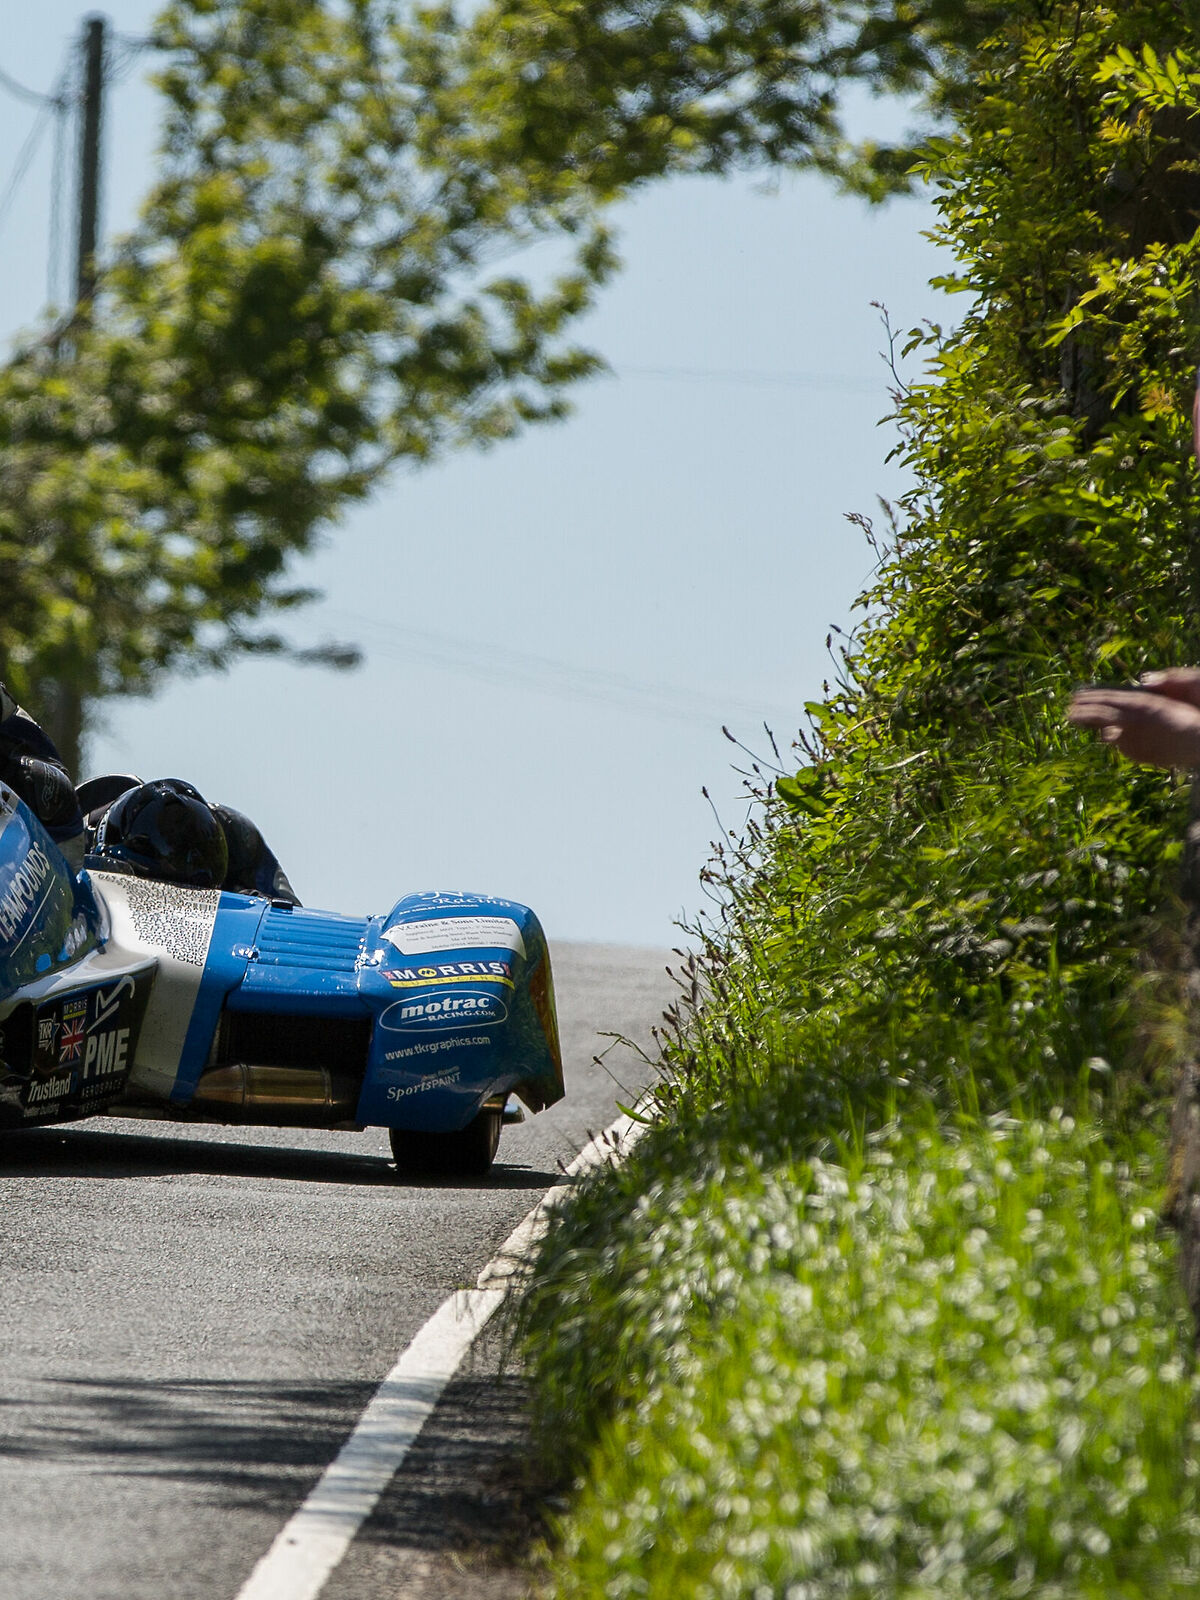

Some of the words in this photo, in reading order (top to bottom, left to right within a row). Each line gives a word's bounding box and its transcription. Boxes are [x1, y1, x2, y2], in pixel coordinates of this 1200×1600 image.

[394, 962, 505, 980] MORRIS
[63, 999, 88, 1014] MORRIS
[400, 997, 490, 1019] motrac
[427, 1010, 496, 1022] RACING.COM
[83, 1027, 130, 1079] PME
[385, 1036, 491, 1061] www.tkrgraphics.com
[27, 1072, 72, 1103] Trustland
[386, 1072, 461, 1101] SportsPAINT
